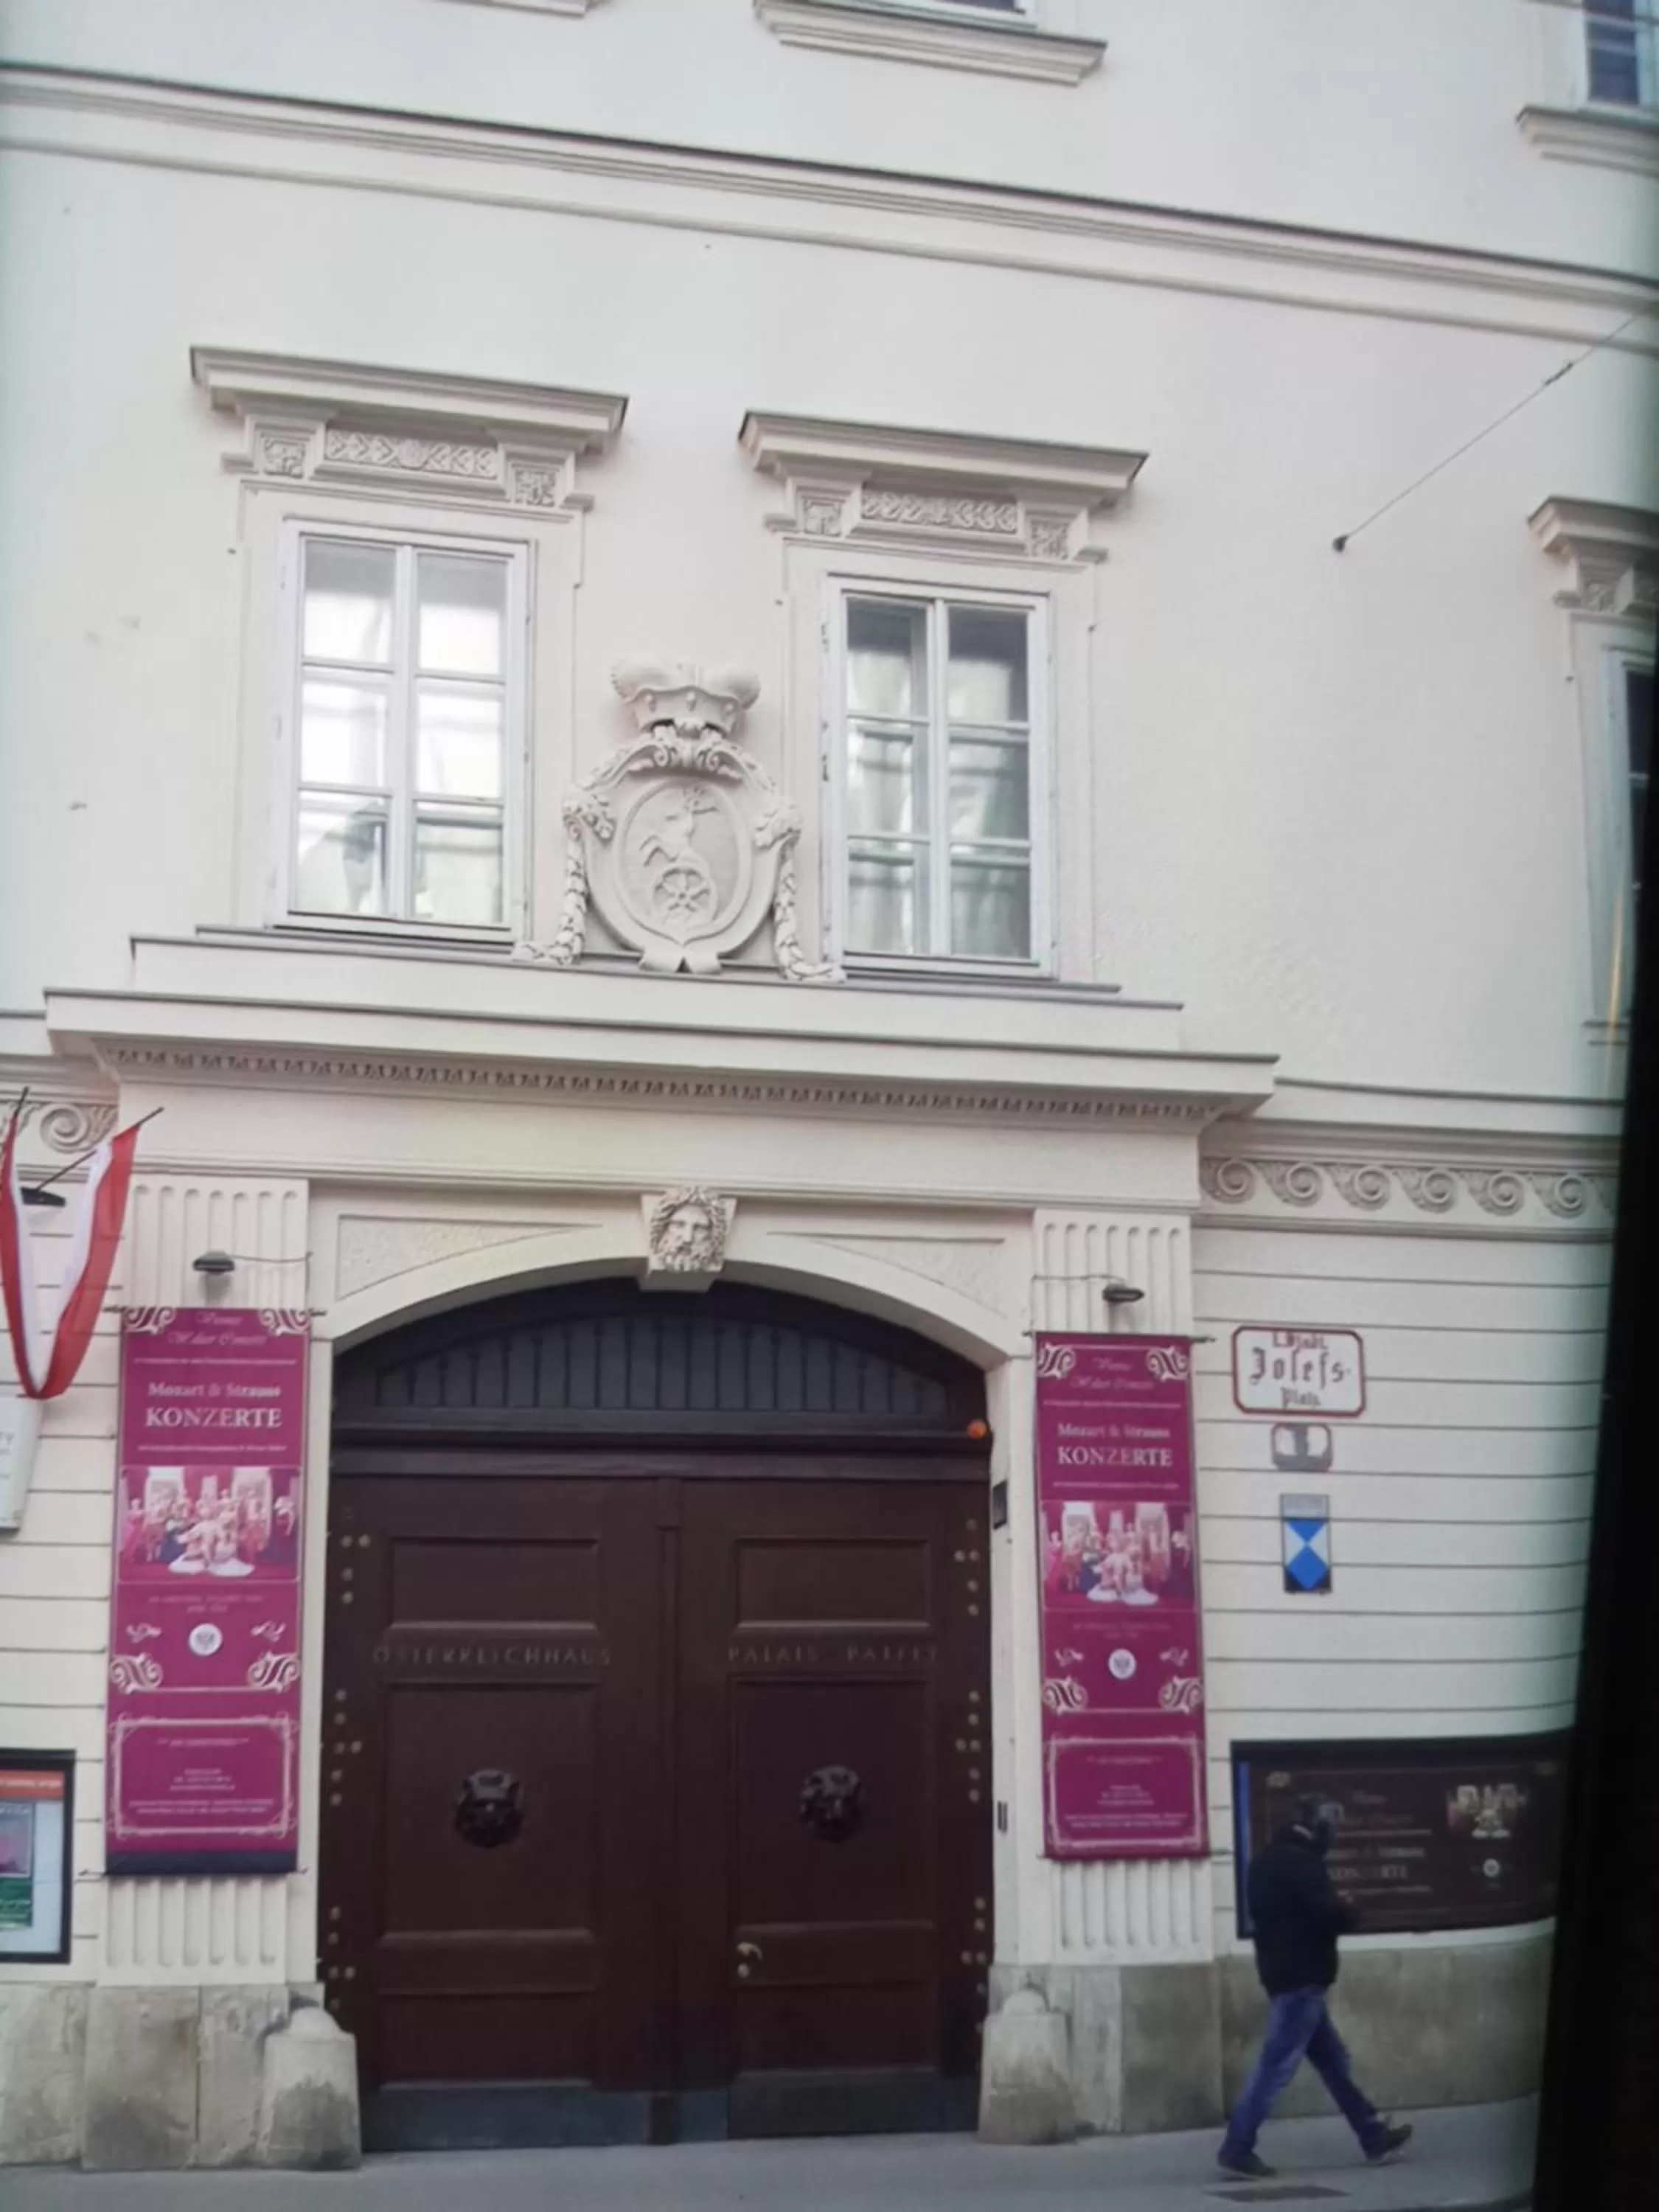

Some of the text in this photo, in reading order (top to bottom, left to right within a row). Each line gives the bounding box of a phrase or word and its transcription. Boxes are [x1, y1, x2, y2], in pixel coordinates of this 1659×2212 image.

[147, 1381, 205, 1397] Mozart
[208, 1382, 222, 1397] &
[145, 1407, 283, 1428] KONZERTE
[1057, 1445, 1174, 1467] KONZERTE
